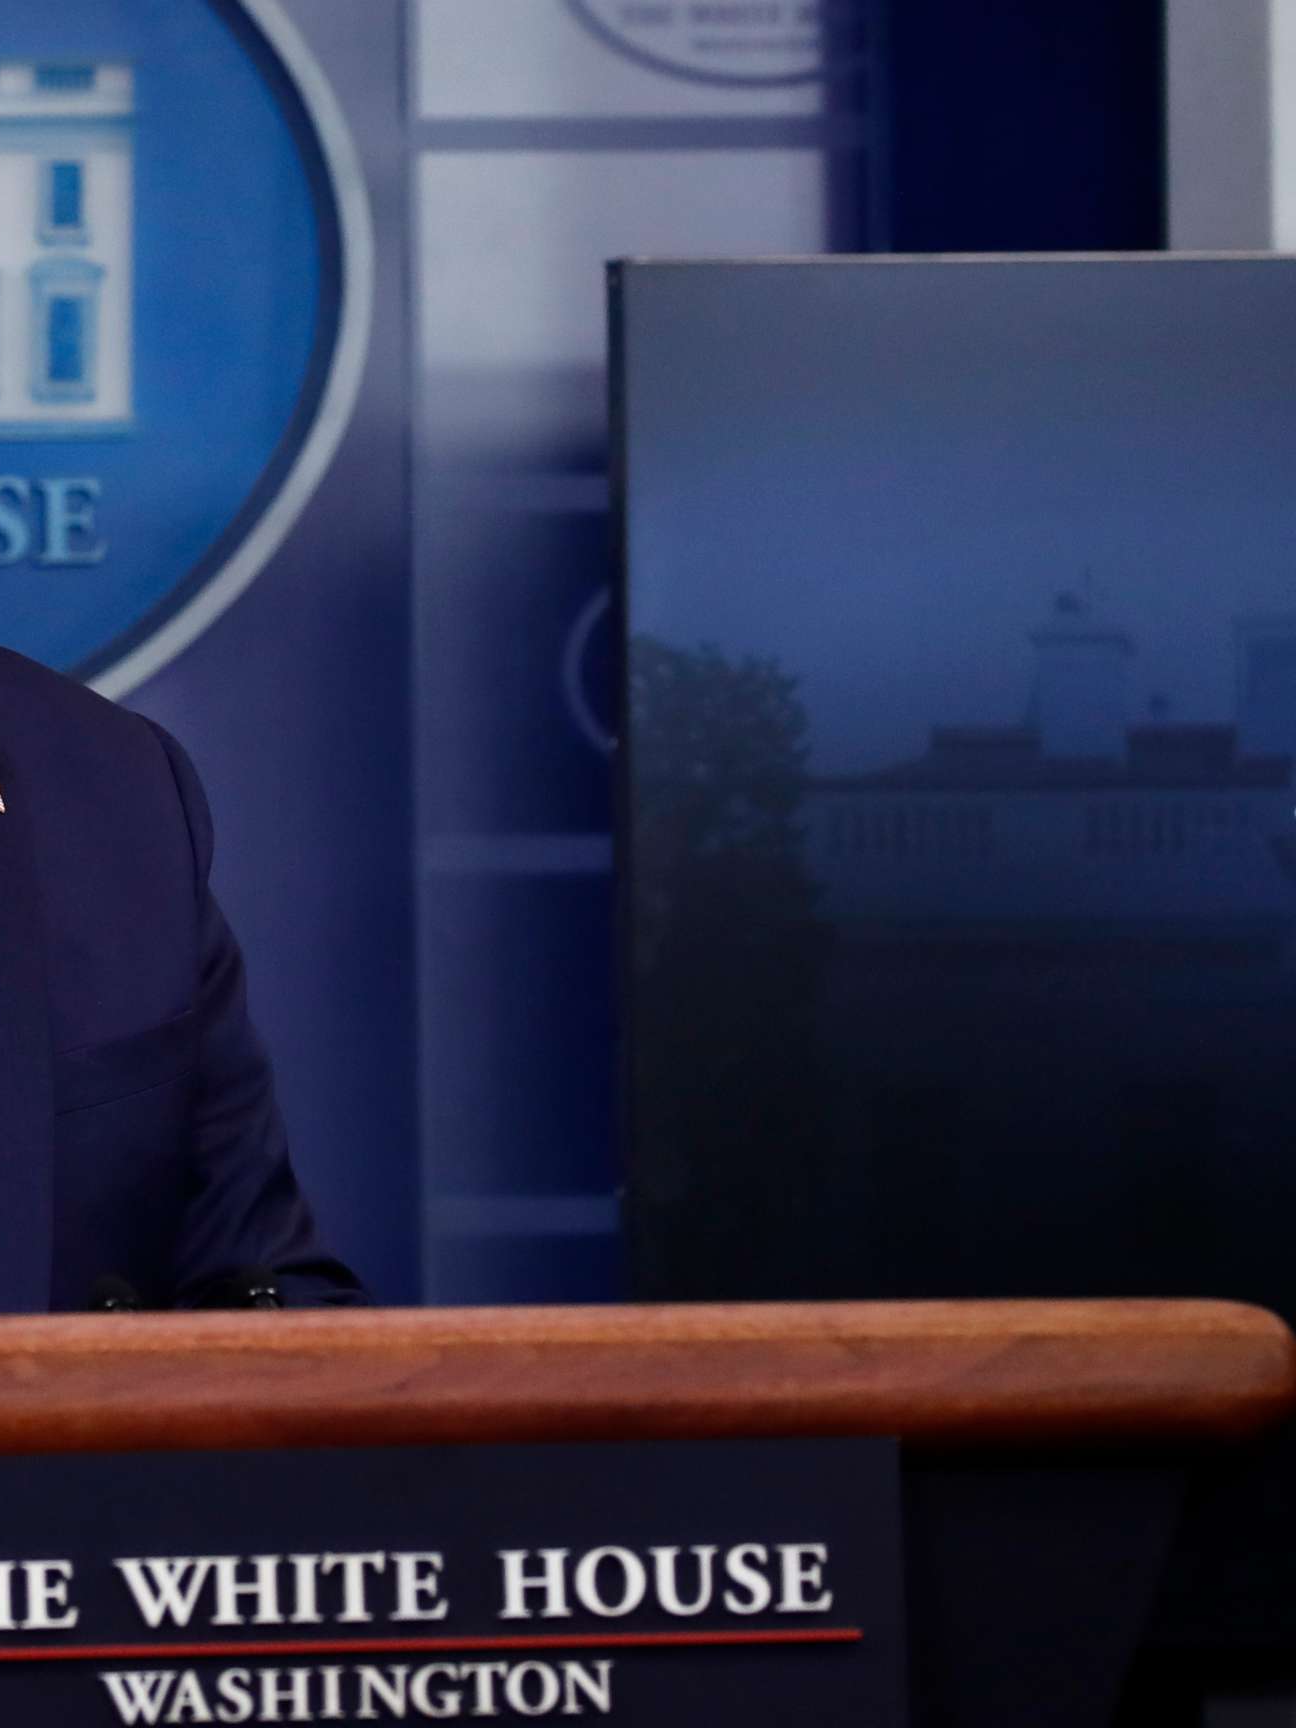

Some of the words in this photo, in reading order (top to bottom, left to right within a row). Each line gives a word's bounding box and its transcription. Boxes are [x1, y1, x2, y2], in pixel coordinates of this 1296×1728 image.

[115, 1551, 448, 1627] WHITE
[500, 1543, 832, 1618] HOUSE
[102, 1661, 610, 1724] WASHINGTON
